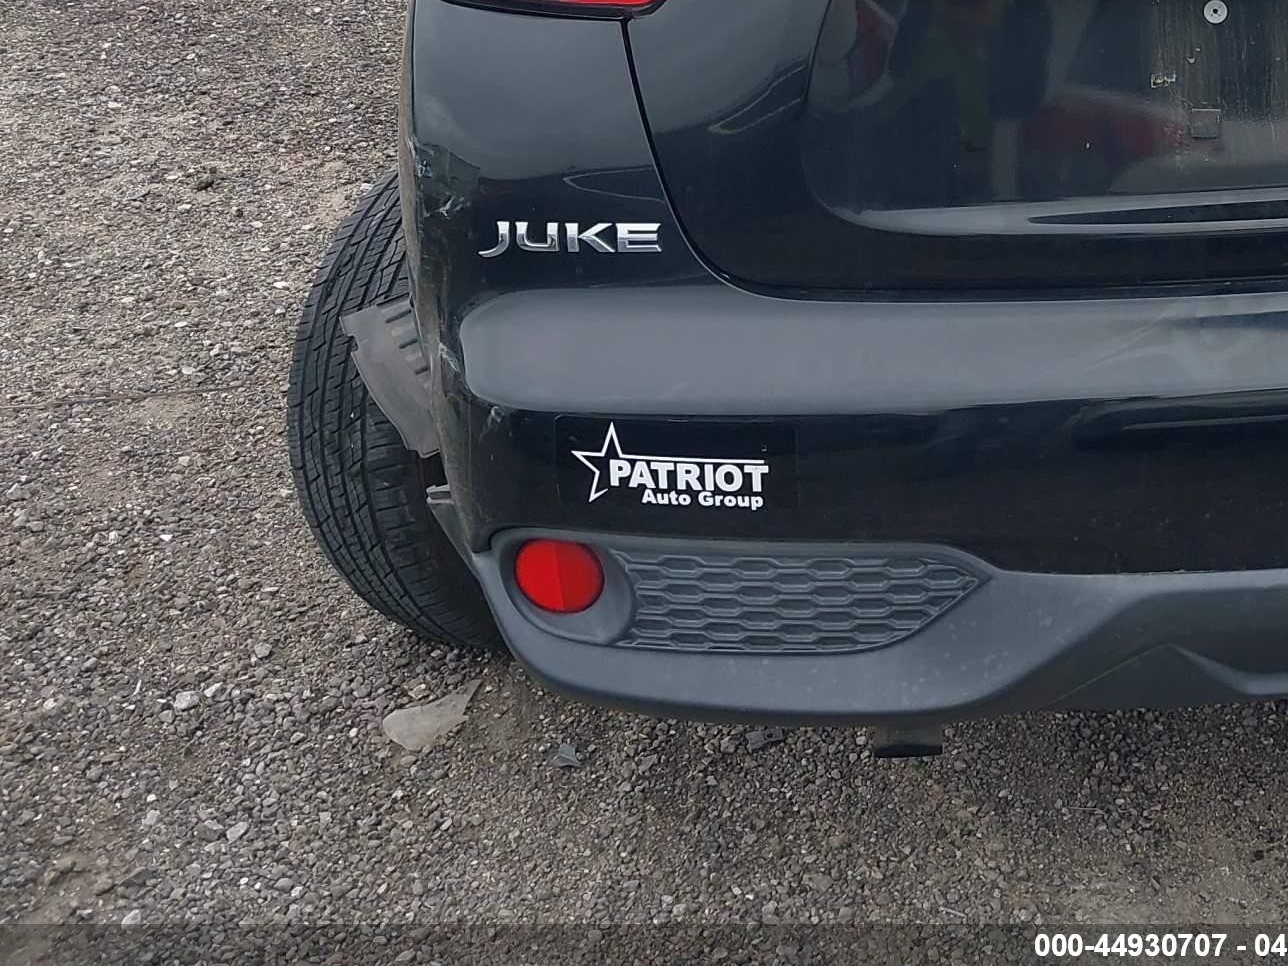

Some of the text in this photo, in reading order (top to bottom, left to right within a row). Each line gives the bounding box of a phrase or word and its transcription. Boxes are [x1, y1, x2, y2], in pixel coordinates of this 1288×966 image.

[478, 221, 663, 258] JUKE
[609, 459, 770, 493] PATRIOT
[641, 488, 764, 511] Auto Group
